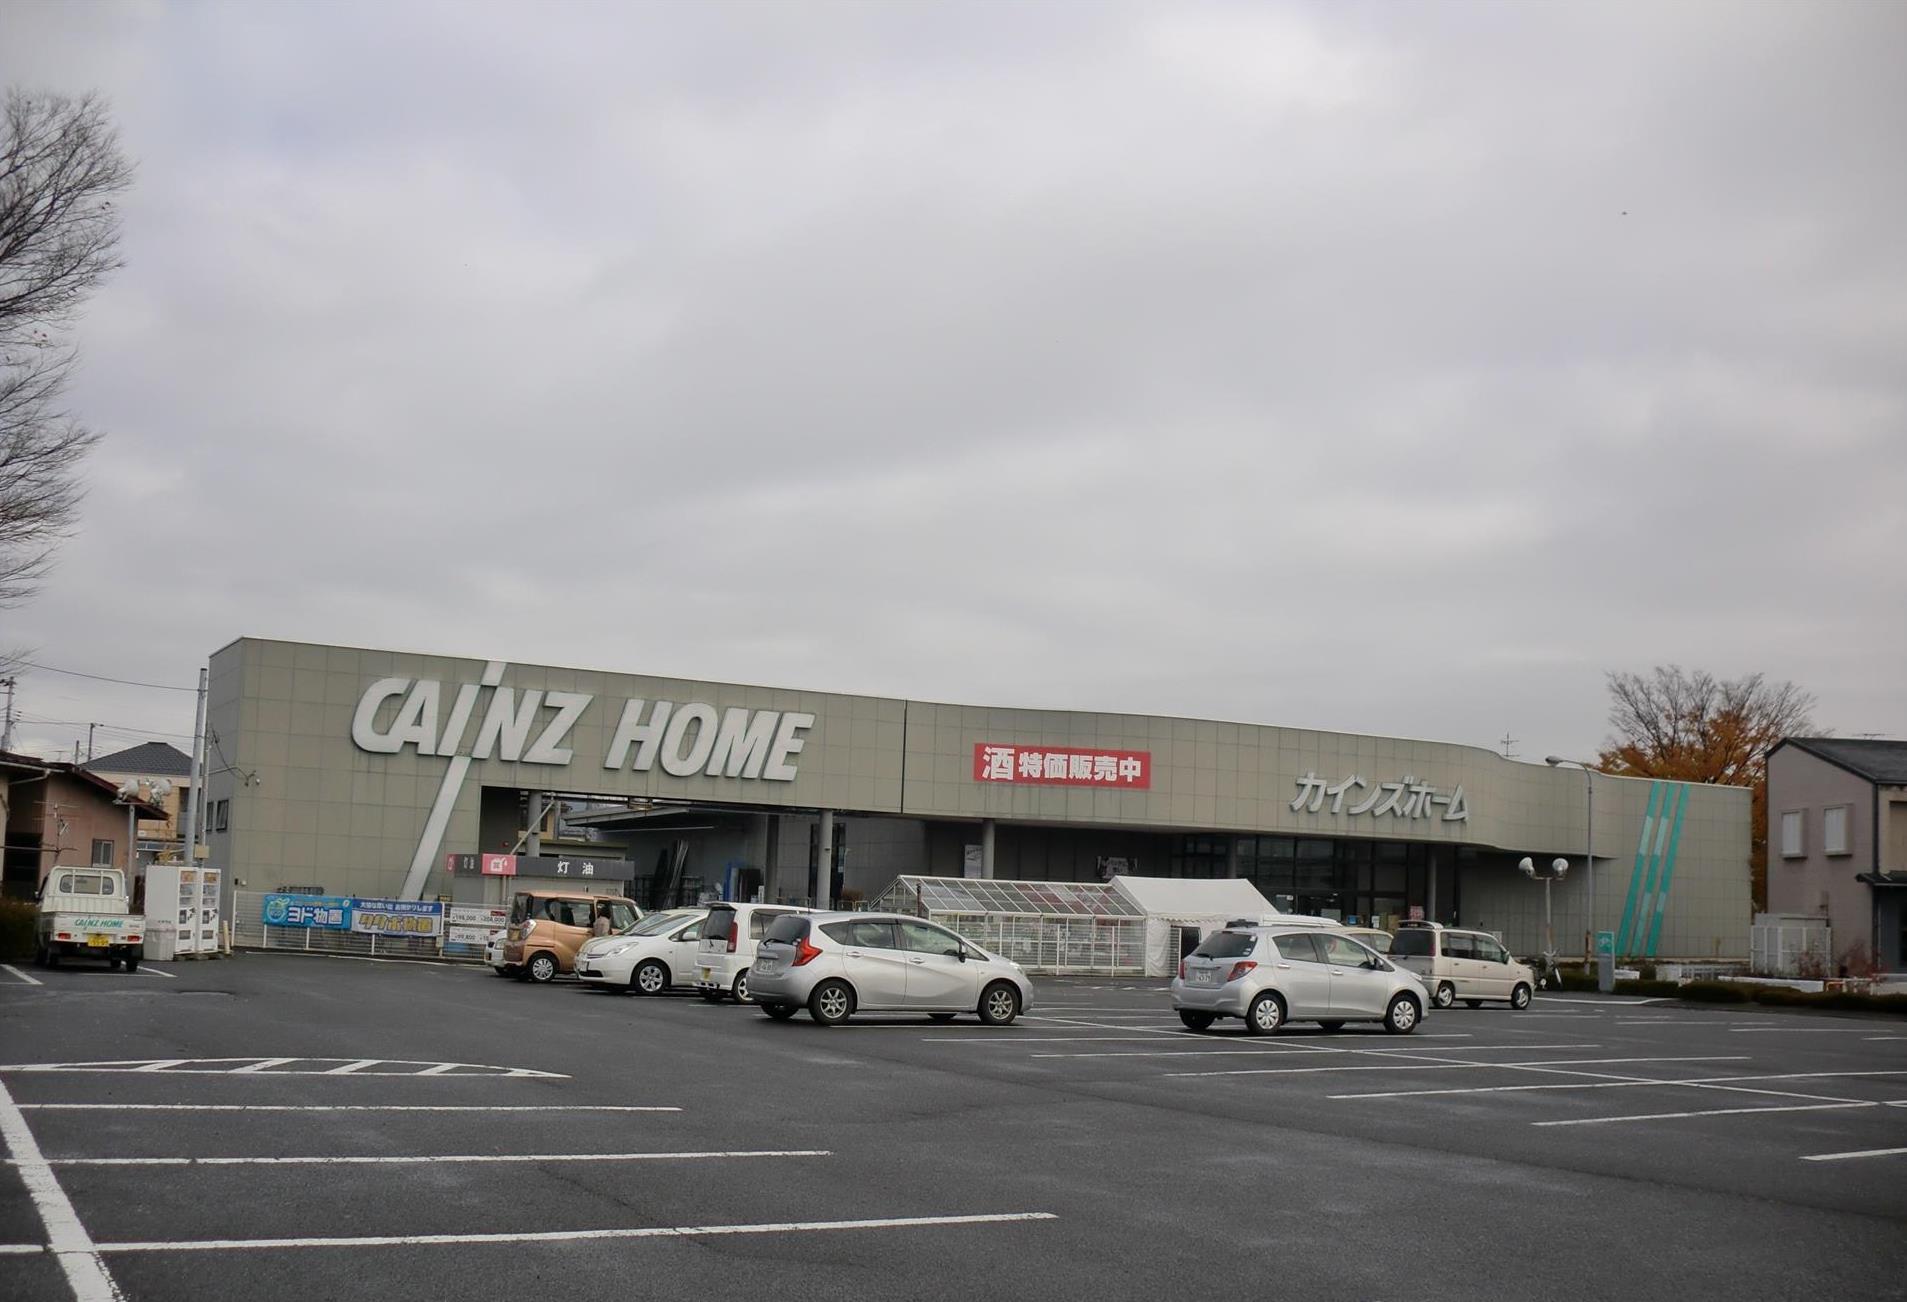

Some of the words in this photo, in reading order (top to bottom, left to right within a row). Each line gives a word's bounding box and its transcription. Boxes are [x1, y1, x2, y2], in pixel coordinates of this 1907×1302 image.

[352, 661, 594, 766] CAINZ
[604, 697, 815, 782] HOME
[1289, 772, 1469, 822] カインズホーム
[557, 860, 594, 875] 灯油
[99, 919, 124, 928] HOME
[287, 906, 343, 925] ヨド物置
